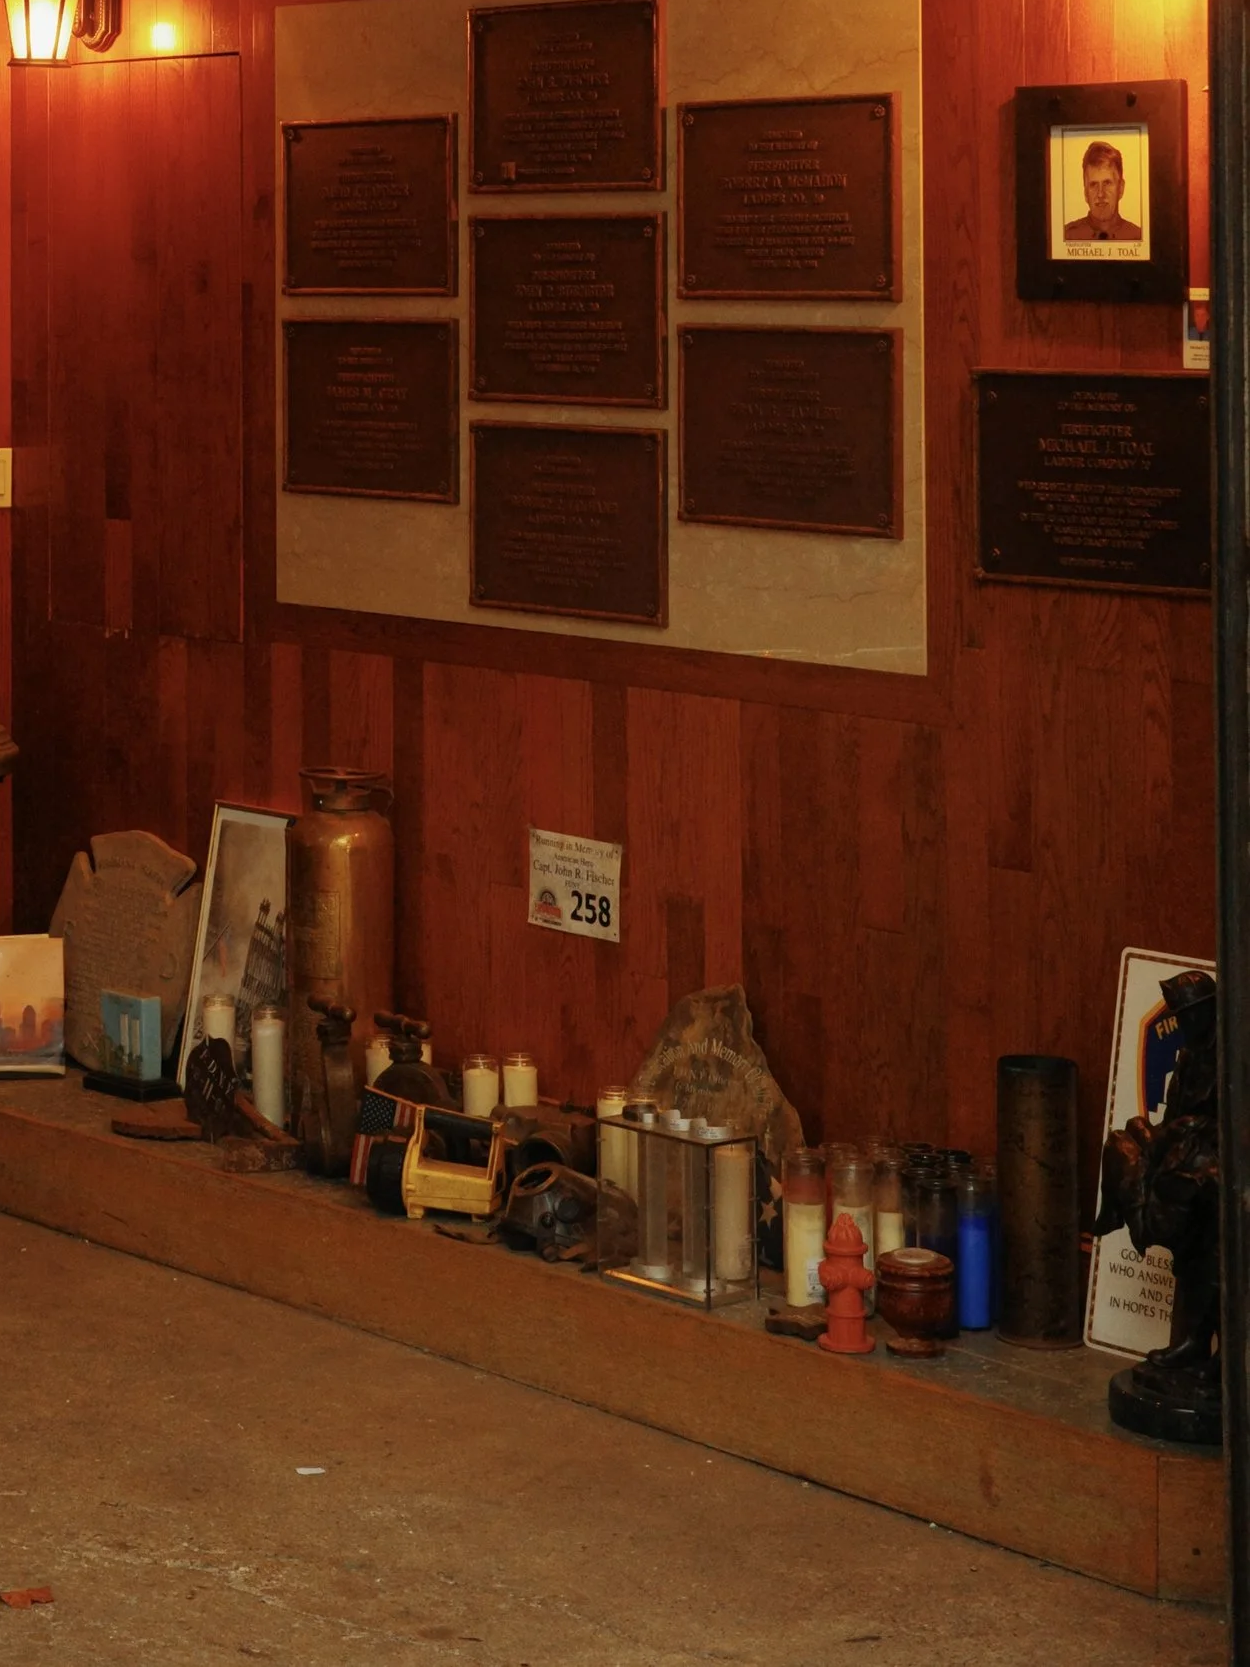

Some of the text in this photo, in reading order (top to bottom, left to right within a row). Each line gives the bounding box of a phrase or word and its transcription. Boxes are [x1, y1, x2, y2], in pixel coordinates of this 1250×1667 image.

[1066, 247, 1104, 257] MICHAEL
[1117, 247, 1141, 257] TOAL
[1061, 423, 1133, 437] FIREFIGHTER
[1039, 438, 1099, 454] MICHAEL
[1118, 441, 1155, 456] TOAL
[533, 859, 615, 886] Capt. John R. Fischer
[570, 890, 611, 928] 258
[1155, 1015, 1179, 1041] FIR
[687, 1037, 709, 1054] And
[1121, 1248, 1144, 1263] GOD
[1109, 1262, 1174, 1289] WHO ANSWE
[1139, 1287, 1163, 1302] AND
[1109, 1296, 1121, 1308] IN
[1123, 1299, 1156, 1318] HOPES
[1158, 1308, 1172, 1322] TH
